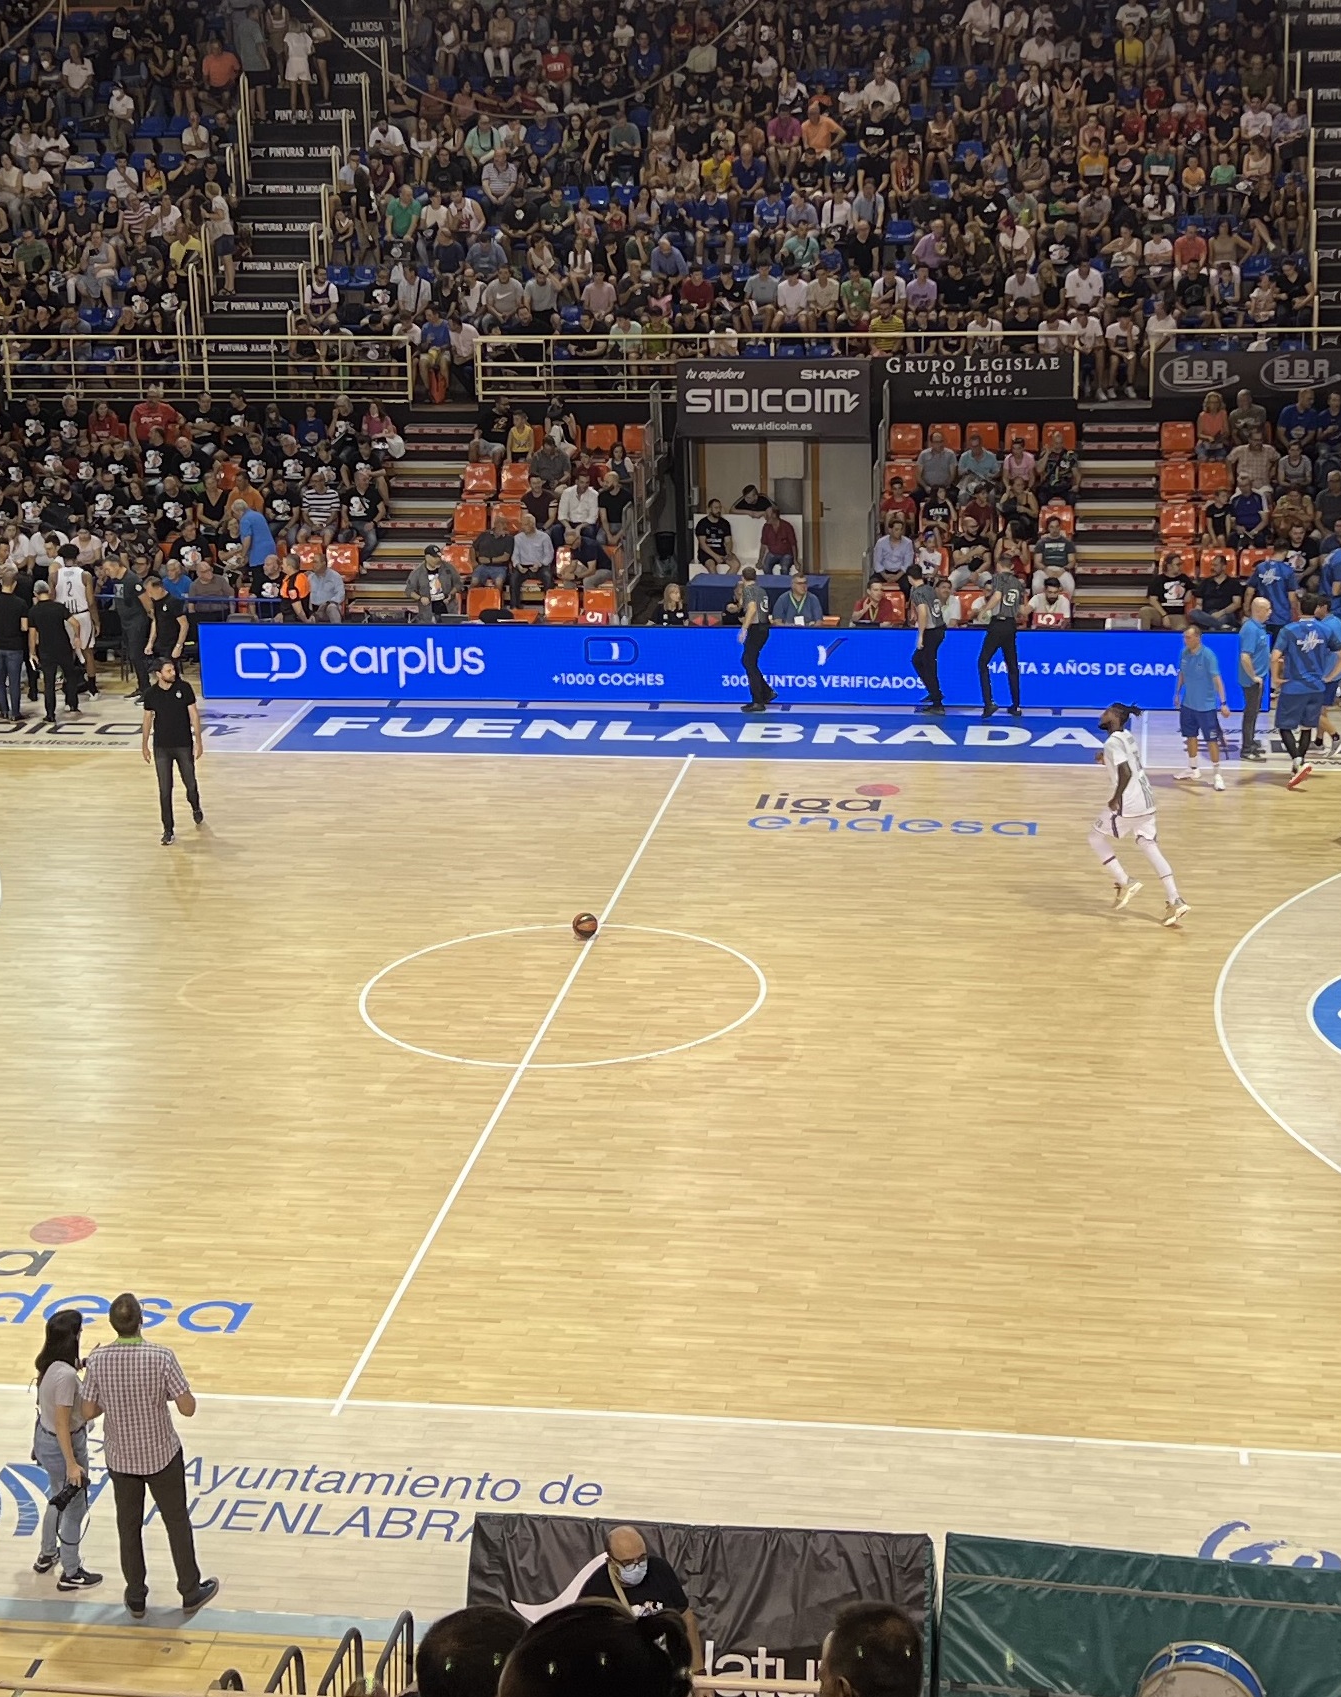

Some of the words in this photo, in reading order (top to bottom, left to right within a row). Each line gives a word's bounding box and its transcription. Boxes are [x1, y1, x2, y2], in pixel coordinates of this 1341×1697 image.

[269, 147, 304, 157] PINTURAS
[886, 357, 956, 375] GRUPO
[964, 355, 1060, 373] LEGISLAE
[800, 369, 859, 380] SHARP
[929, 372, 1012, 388] Abogados
[914, 387, 1028, 399] www.legislae.es
[731, 422, 813, 433] www.sidicoim.es
[66, 581, 73, 596] 2
[320, 637, 485, 688] carplus
[987, 660, 1038, 675] HATA
[1040, 662, 1050, 675] 3
[1055, 658, 1101, 676] AÑOS
[1105, 662, 1126, 676] DE
[552, 673, 595, 686] +1000
[597, 673, 665, 686] COCHES
[721, 675, 749, 688] 300
[765, 676, 818, 689] UNTOS
[820, 676, 925, 689] VERIFICADOS
[313, 715, 1105, 748] FUENLABRADA
[754, 793, 882, 815] liga
[748, 813, 1039, 837] endesa
[183, 1455, 522, 1502] Ayuntamiento
[539, 1474, 603, 1506] de
